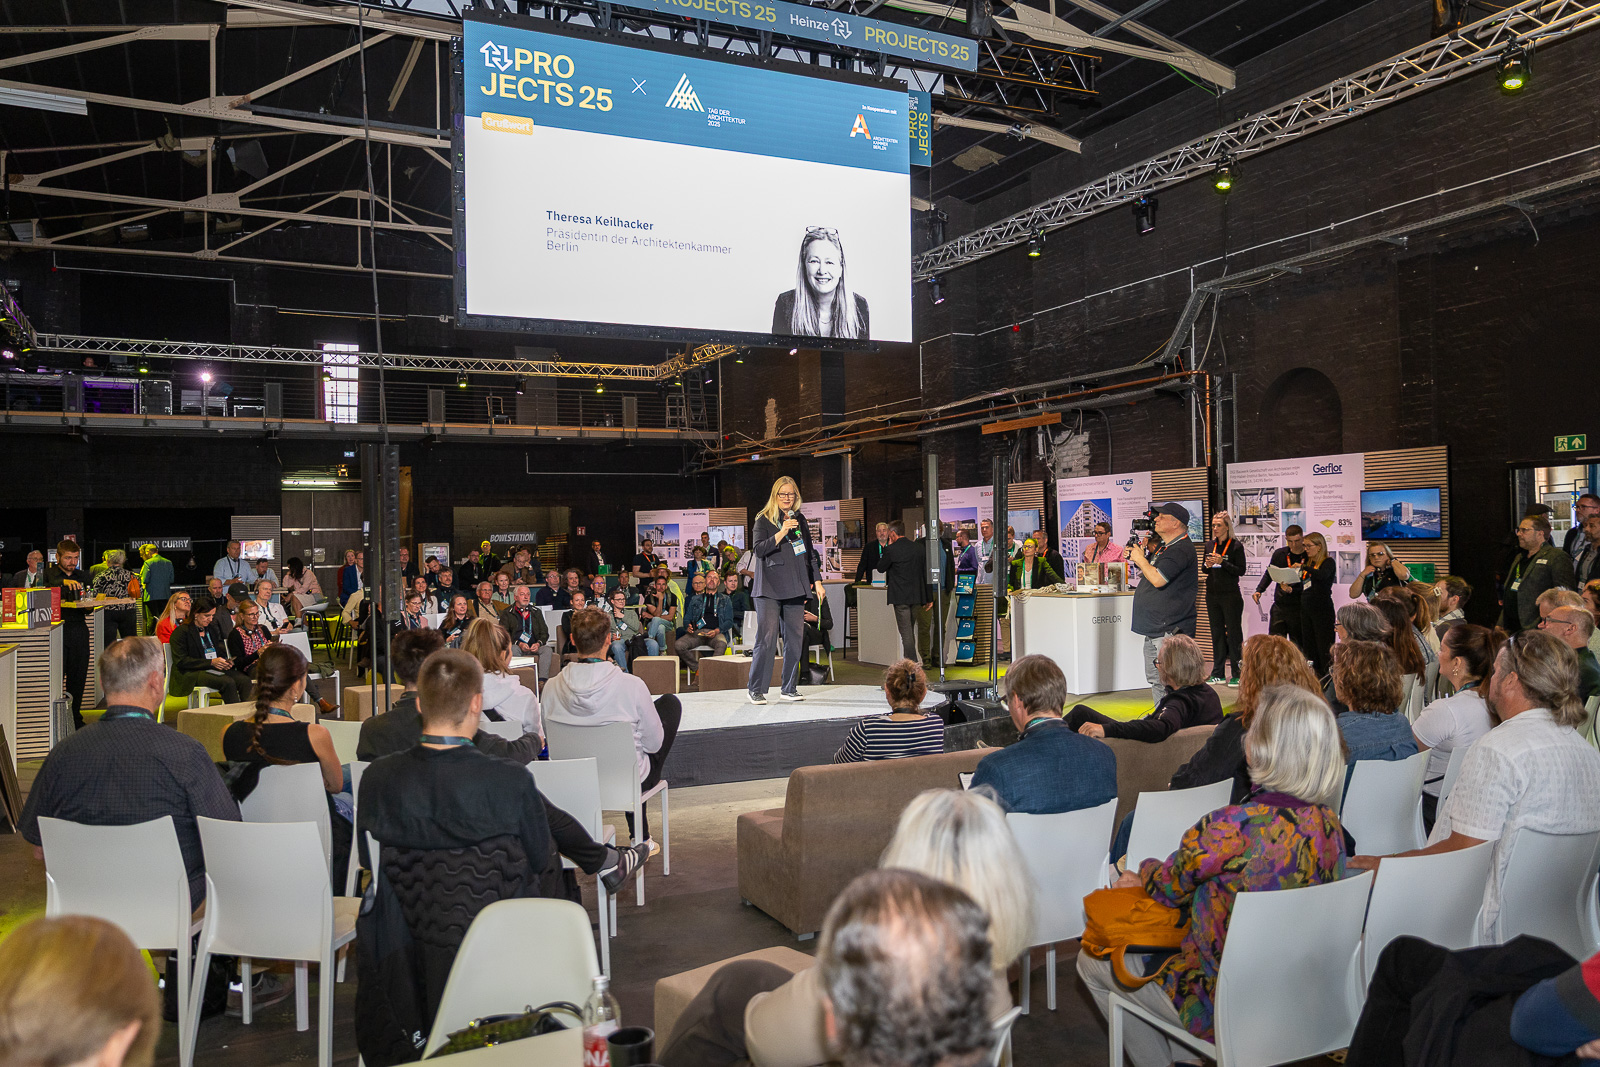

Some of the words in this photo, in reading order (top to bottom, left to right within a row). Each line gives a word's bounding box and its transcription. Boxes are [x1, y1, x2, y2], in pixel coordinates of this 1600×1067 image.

[653, 0, 751, 18] JECTS
[754, 5, 777, 22] 25
[790, 14, 830, 31] Heinze
[864, 26, 949, 56] PROJECTS
[951, 44, 970, 61] 25
[514, 47, 575, 79] PRO
[480, 72, 574, 107] JECTS
[578, 85, 613, 112] 25
[707, 107, 718, 115] TAG
[485, 117, 531, 132] Grußwort
[707, 114, 746, 125] ARCHITEKTUR
[707, 120, 721, 128] 2025
[909, 110, 918, 139] PRO
[873, 136, 898, 144] ARCHITEKTEN
[918, 113, 929, 156] JECTS
[546, 210, 592, 225] Theresa
[595, 215, 654, 231] Keilhacker
[546, 227, 608, 243] Präsidentin
[611, 232, 629, 245] der
[631, 235, 732, 254] Architektenkammer
[546, 240, 579, 252] Berlin
[1313, 462, 1343, 474] Gerflor
[1338, 518, 1353, 526] 83%
[161, 539, 189, 549] CURRY
[490, 533, 534, 543] BOWLSTATION
[1092, 614, 1122, 624] GERFLOR
